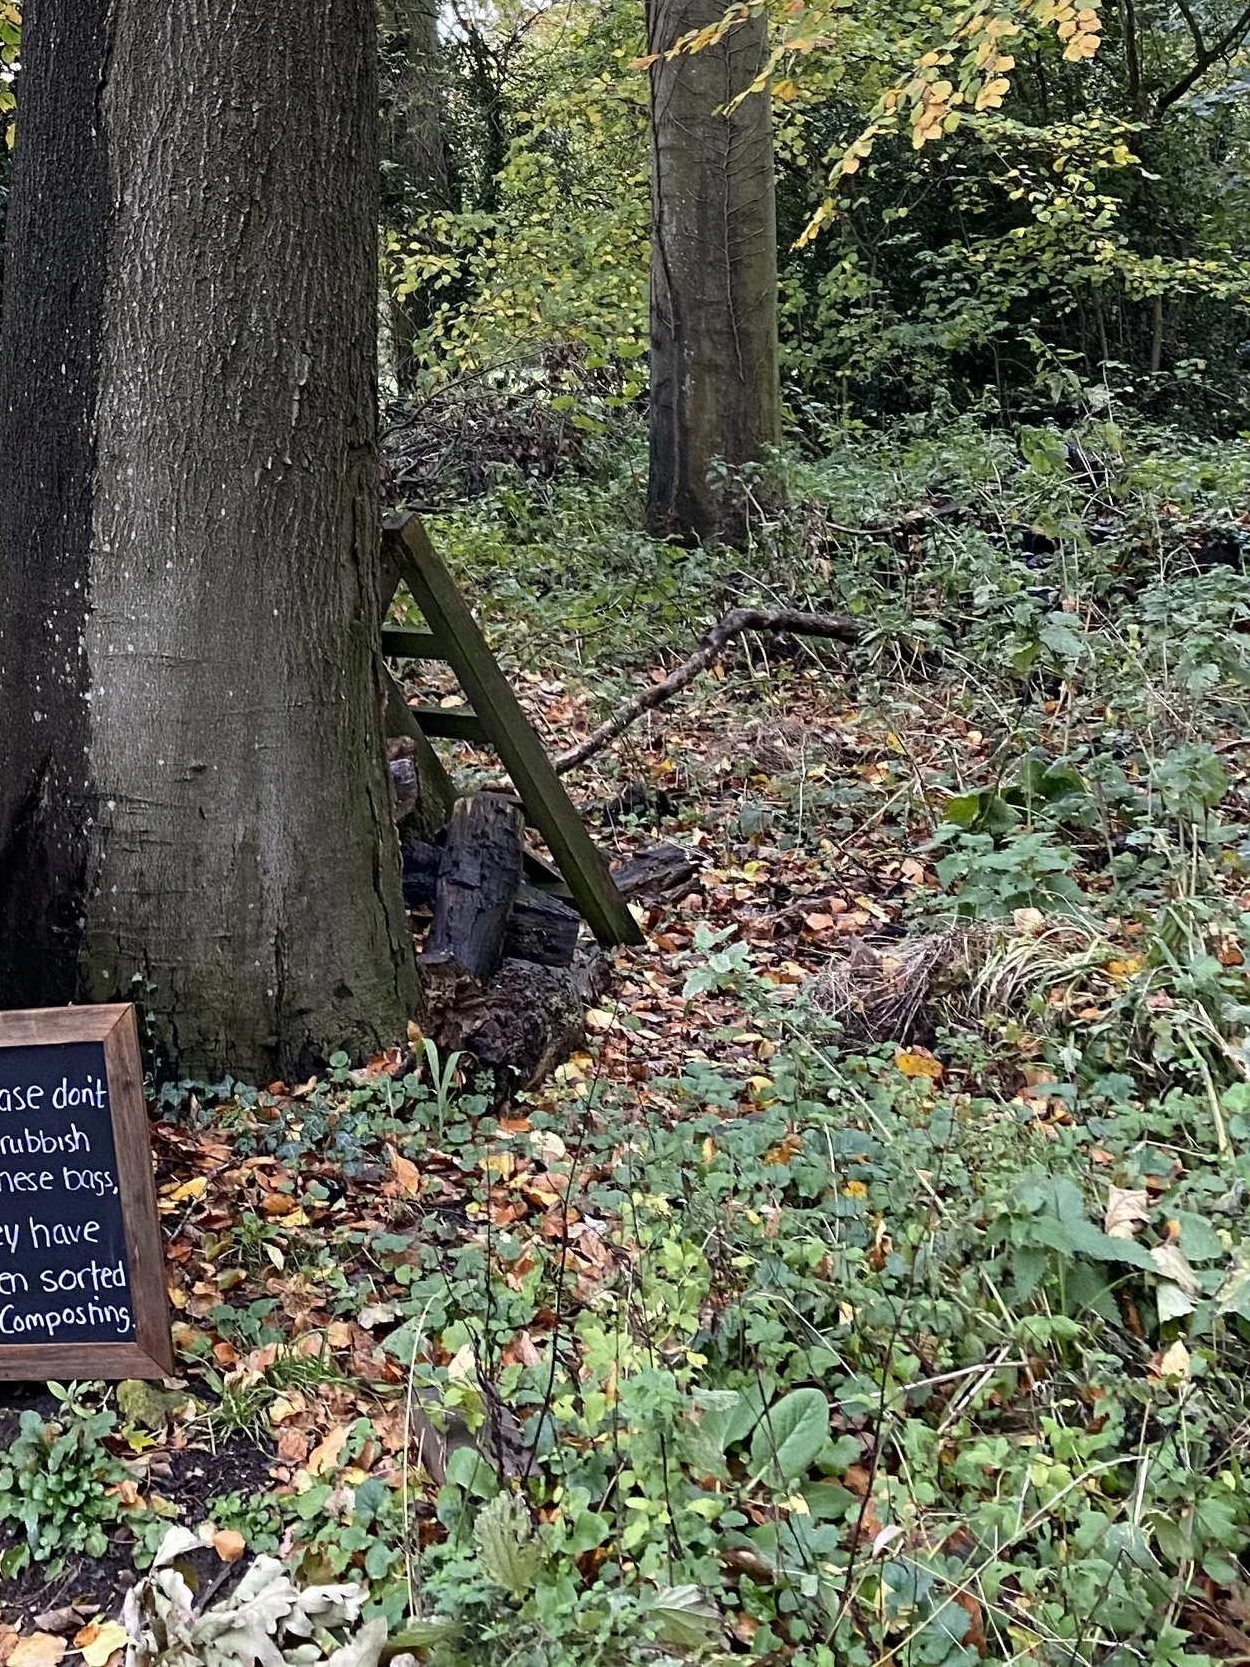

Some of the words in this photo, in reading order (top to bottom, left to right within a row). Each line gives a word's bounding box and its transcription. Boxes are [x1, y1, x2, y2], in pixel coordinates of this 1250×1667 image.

[52, 1074, 107, 1109] don't
[0, 1123, 90, 1154] rubbish
[30, 1217, 100, 1248] have
[40, 1260, 126, 1292] sorted
